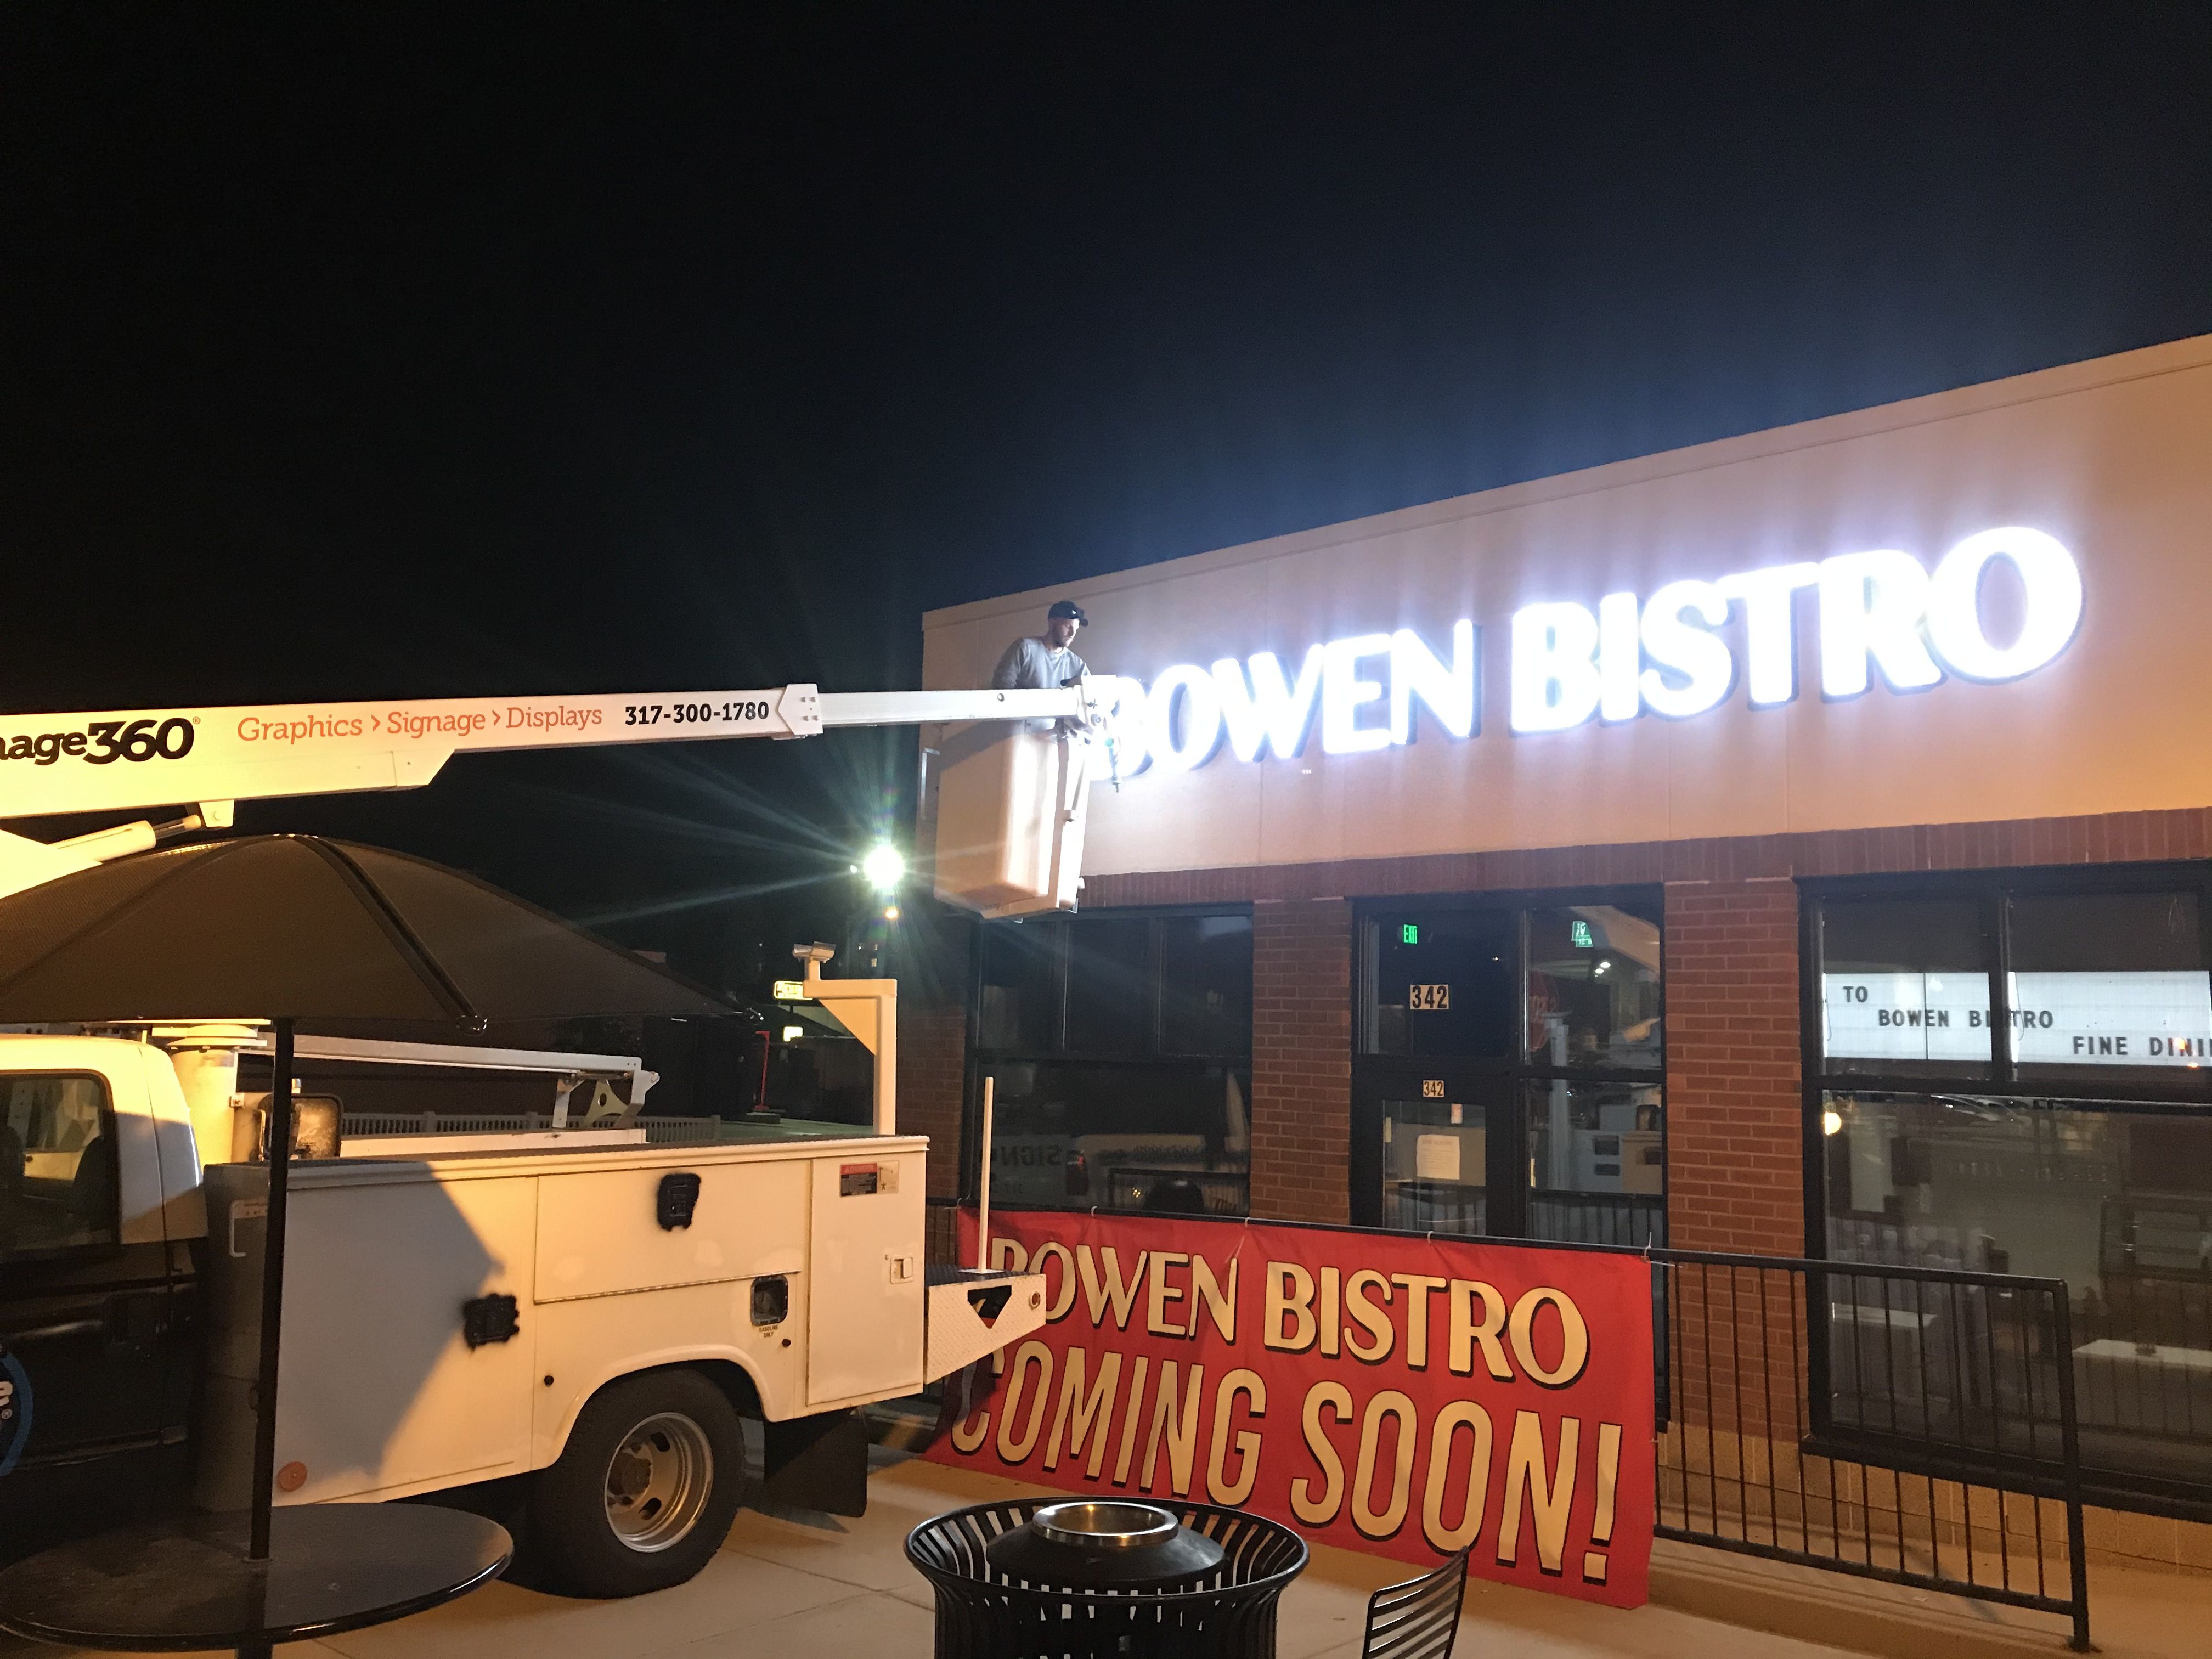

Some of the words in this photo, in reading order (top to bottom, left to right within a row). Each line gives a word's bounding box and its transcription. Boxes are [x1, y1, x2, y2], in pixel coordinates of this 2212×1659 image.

[1510, 526, 2084, 736] BISTRO
[238, 714, 363, 745] Graphics
[387, 709, 486, 738] Signage
[506, 704, 602, 733] Displays
[624, 702, 770, 726] 317-300-1780
[0, 717, 195, 766] age360
[1404, 924, 1418, 944] EXIT
[1412, 985, 1448, 1009] 342
[1842, 985, 1869, 1003] TO
[1878, 1009, 1950, 1028] BOWEN
[1969, 1010, 2054, 1029] BITRO
[2073, 1036, 2128, 1055] FINE
[2149, 1037, 2212, 1057] DINI
[1423, 1081, 1444, 1097] 342
[1263, 1260, 1590, 1390] BISTRO
[951, 1340, 1267, 1508] COMING
[1290, 1380, 1623, 1585] SOON!
